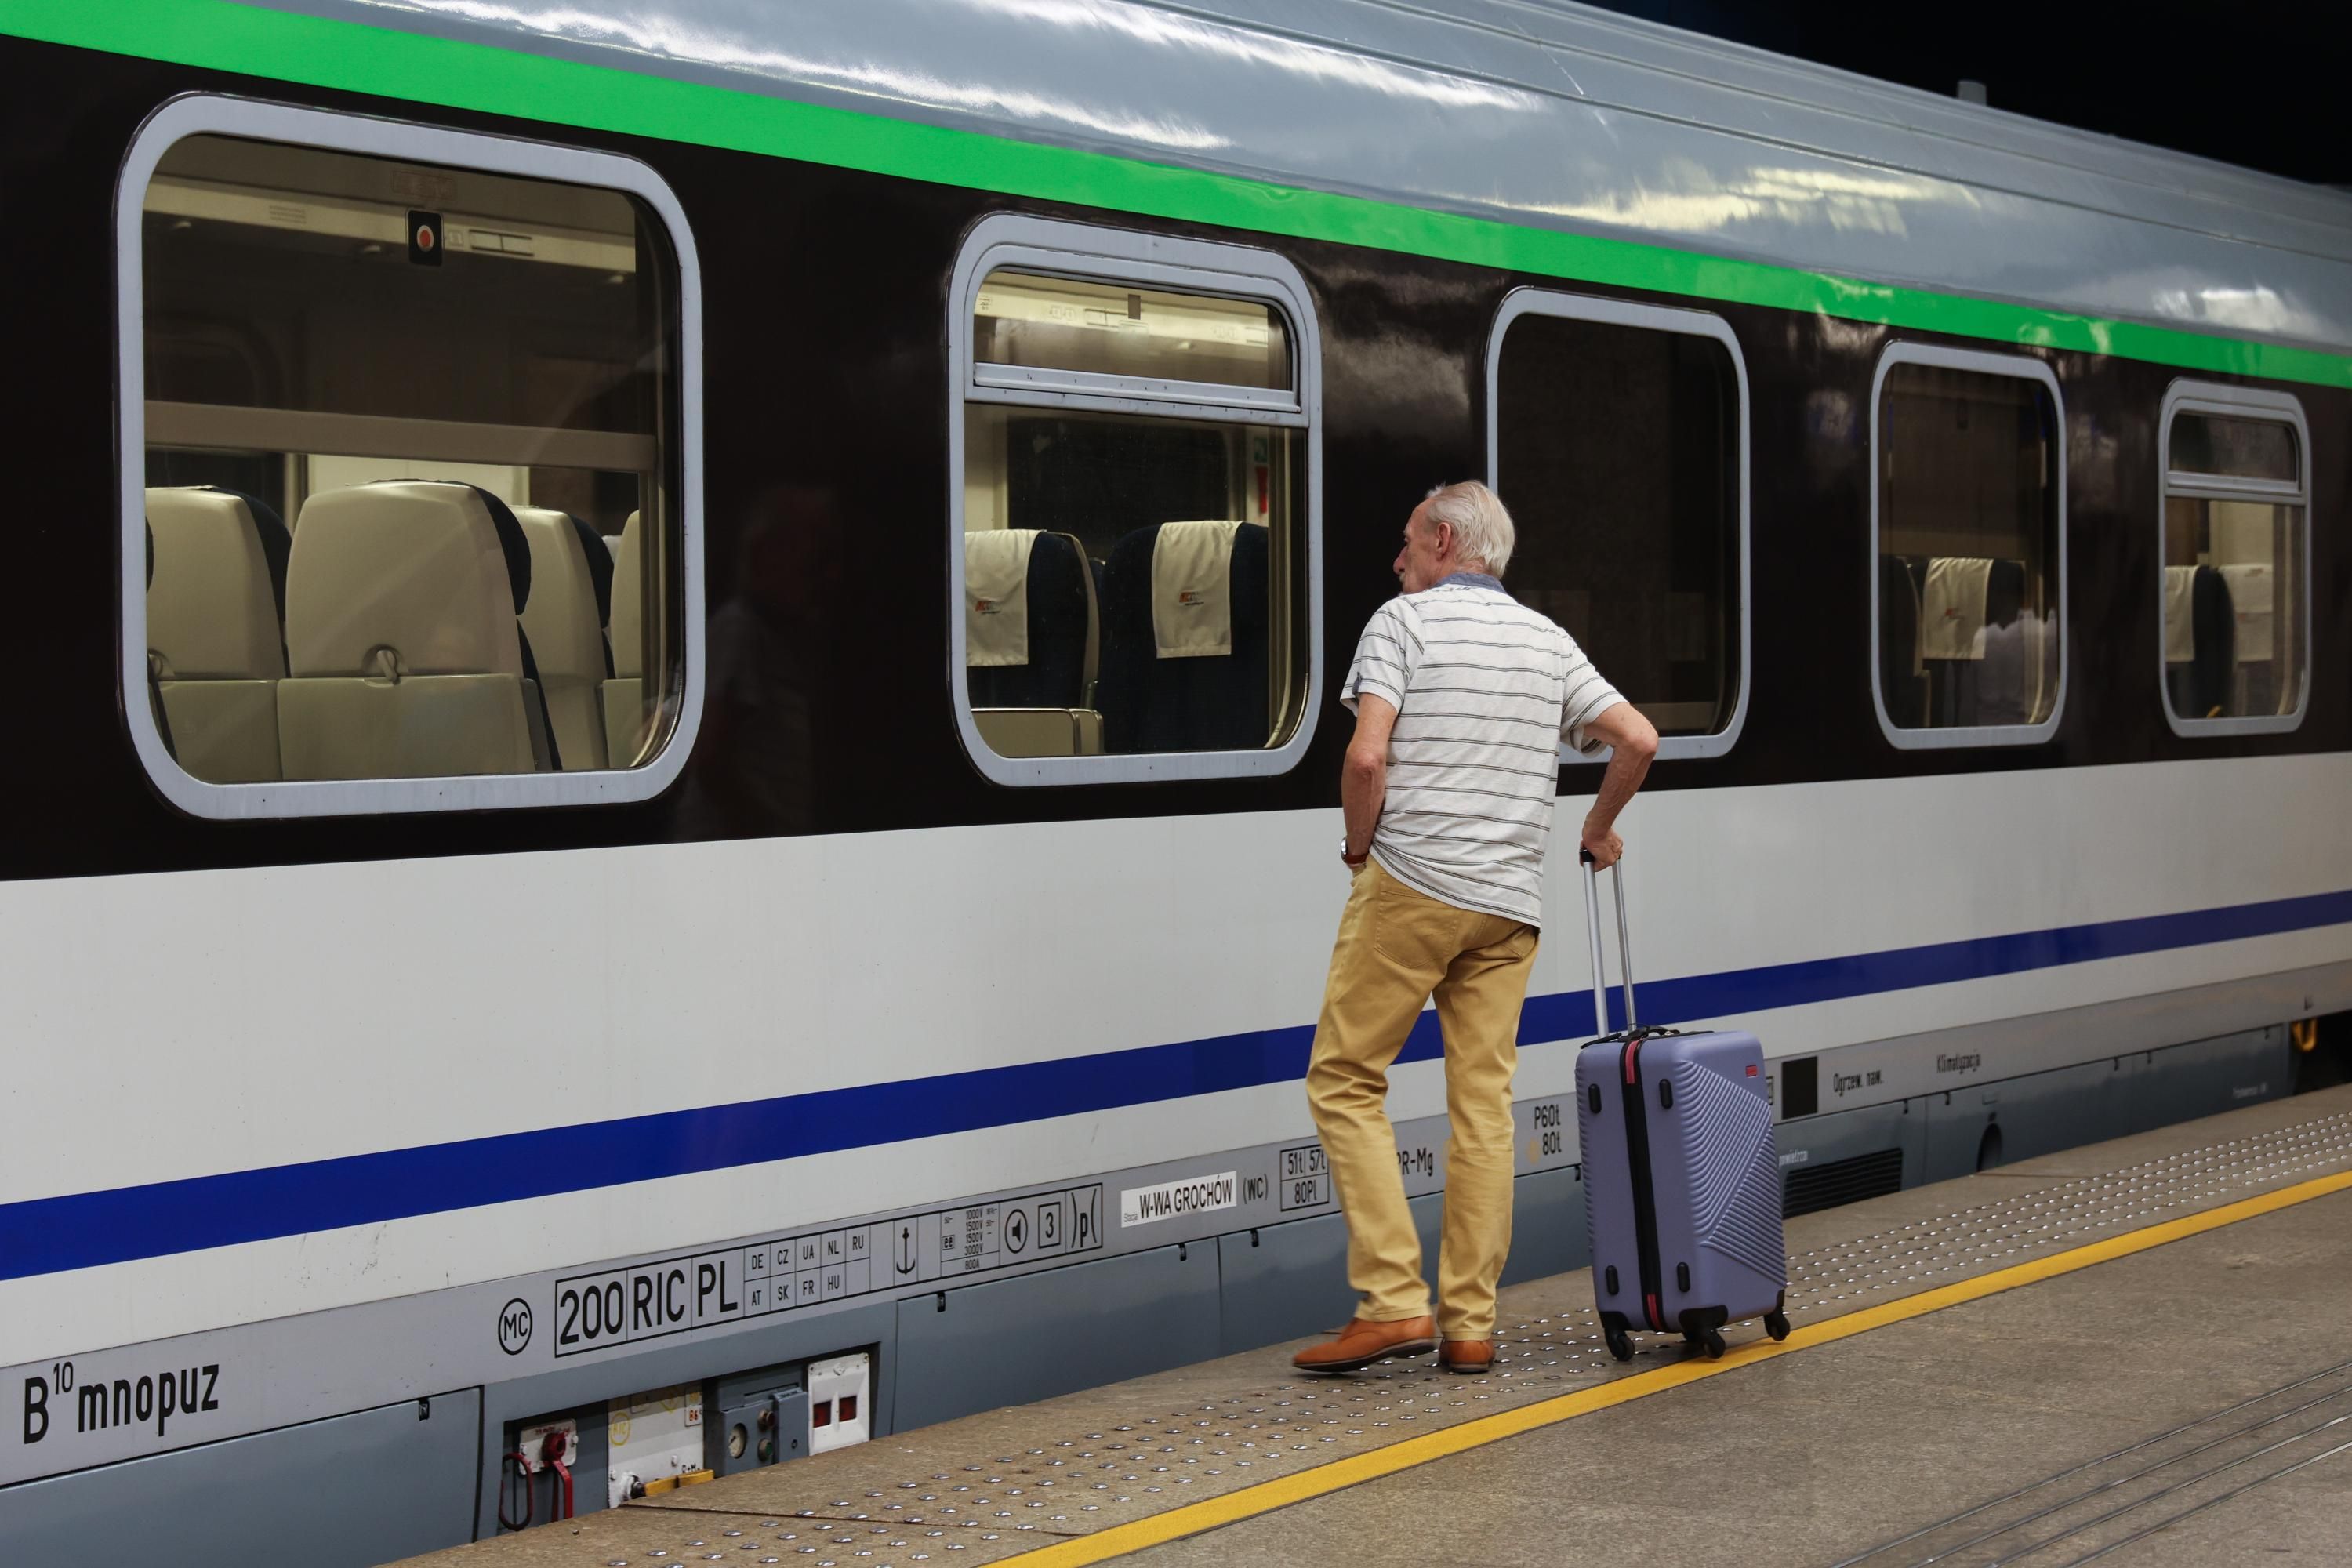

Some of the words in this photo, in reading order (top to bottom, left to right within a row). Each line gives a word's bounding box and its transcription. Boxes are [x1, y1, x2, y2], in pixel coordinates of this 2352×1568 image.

[1534, 1104, 1561, 1130] P60t
[1542, 1131, 1562, 1156] 80t
[1288, 1152, 1303, 1175] 51t
[1139, 1190, 1172, 1219] W-WA
[1174, 1175, 1232, 1213] GROCHÓW
[1045, 1211, 1054, 1239] 3
[803, 1244, 815, 1261] UA
[828, 1240, 840, 1255] NL
[852, 1235, 864, 1250] RU
[752, 1254, 764, 1270] DE
[777, 1248, 789, 1265] CZ
[698, 1261, 738, 1317] PL
[777, 1284, 789, 1301] SK
[802, 1279, 815, 1296] FR
[827, 1275, 840, 1290] HU
[633, 1269, 685, 1330] RIC
[751, 1290, 762, 1306] AT
[560, 1281, 624, 1345] 200
[503, 1311, 528, 1341] MC
